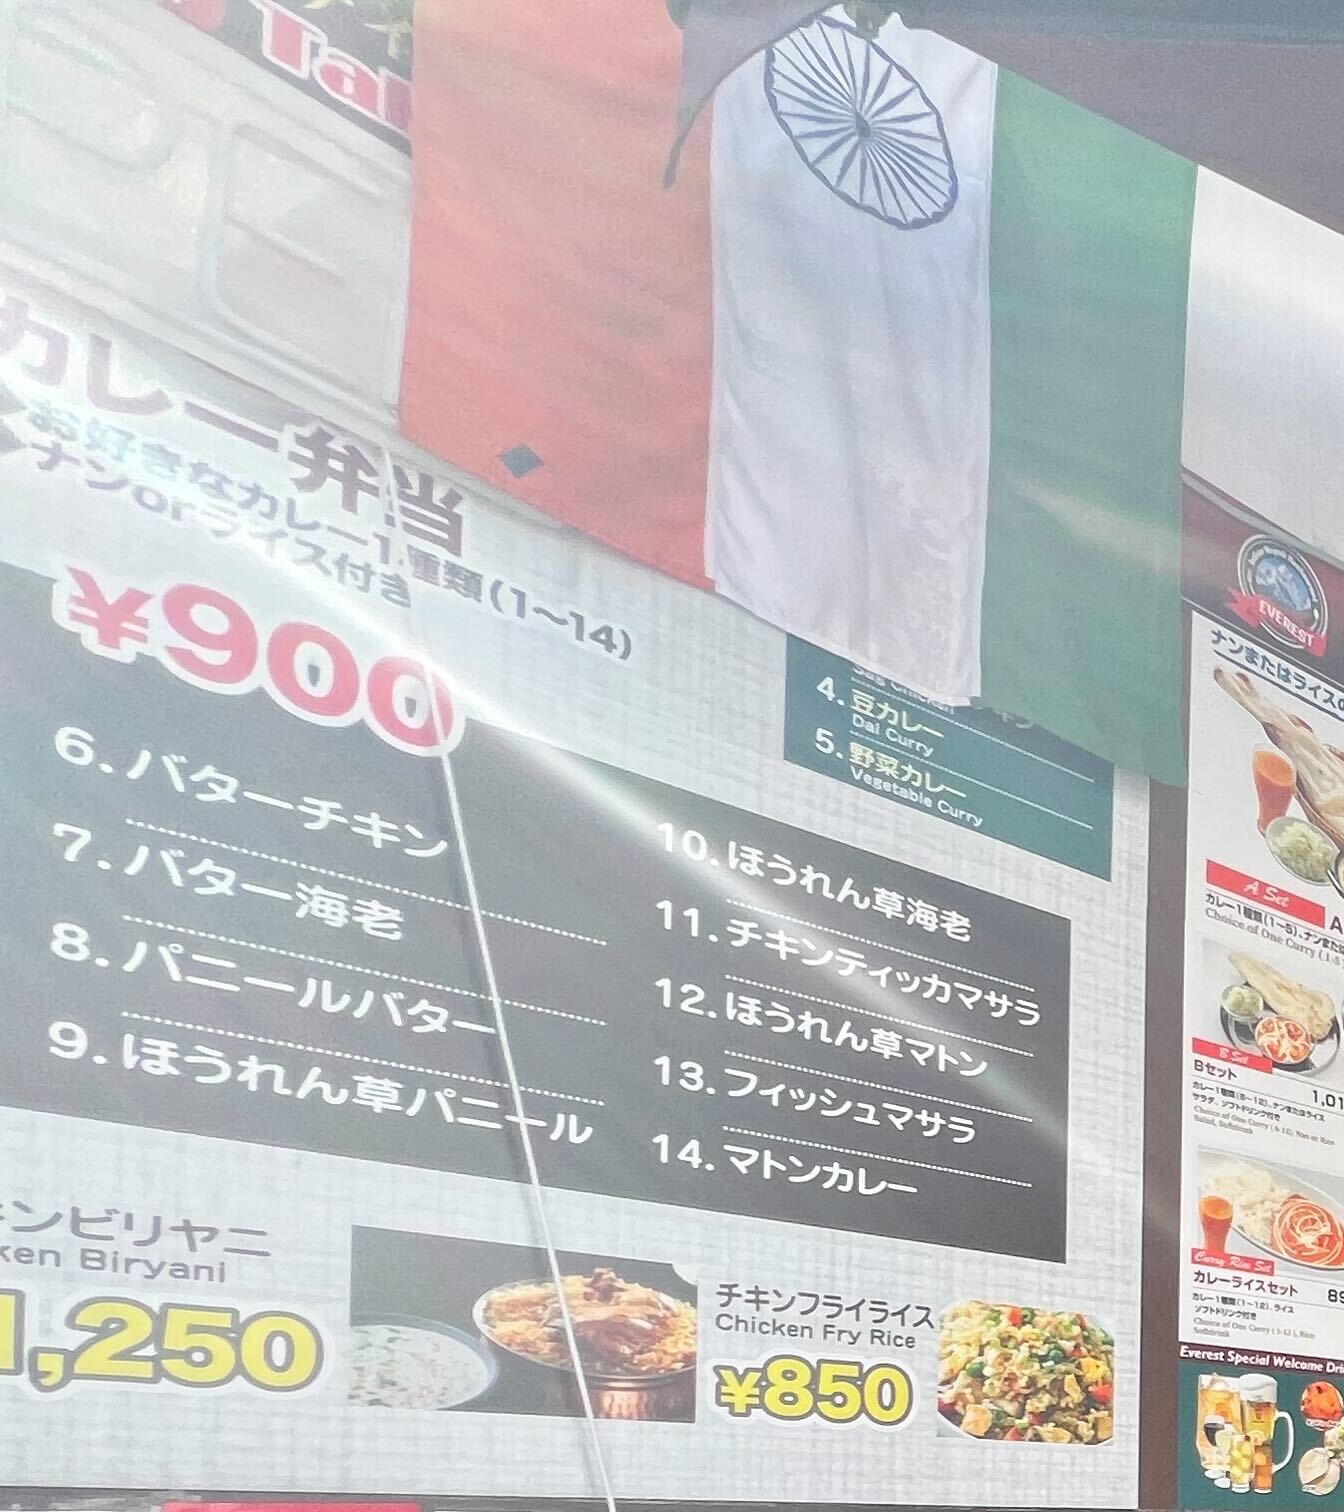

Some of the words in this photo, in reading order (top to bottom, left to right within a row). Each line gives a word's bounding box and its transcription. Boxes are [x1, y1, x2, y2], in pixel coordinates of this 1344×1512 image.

[0, 301, 464, 558] カレー弁当
[1259, 599, 1314, 648] EVEREST
[66, 568, 454, 749] ¥900
[852, 714, 880, 734] Dal
[886, 726, 934, 758] Curry
[850, 766, 932, 809] Vegetable
[937, 800, 984, 828] Curry
[0, 1201, 271, 1257] ンビリヤニ
[80, 1249, 227, 1284] Biryani
[1194, 1271, 1298, 1297] カレーライスセット
[716, 1283, 934, 1328] チキンフライライス
[716, 1314, 813, 1339] Chicken
[823, 1320, 861, 1346] Fry
[871, 1330, 916, 1349] Rice
[1180, 1346, 1229, 1362] Everest
[1227, 1351, 1270, 1367] Special
[1273, 1355, 1322, 1372] Welcome
[716, 1354, 912, 1426] ¥850
